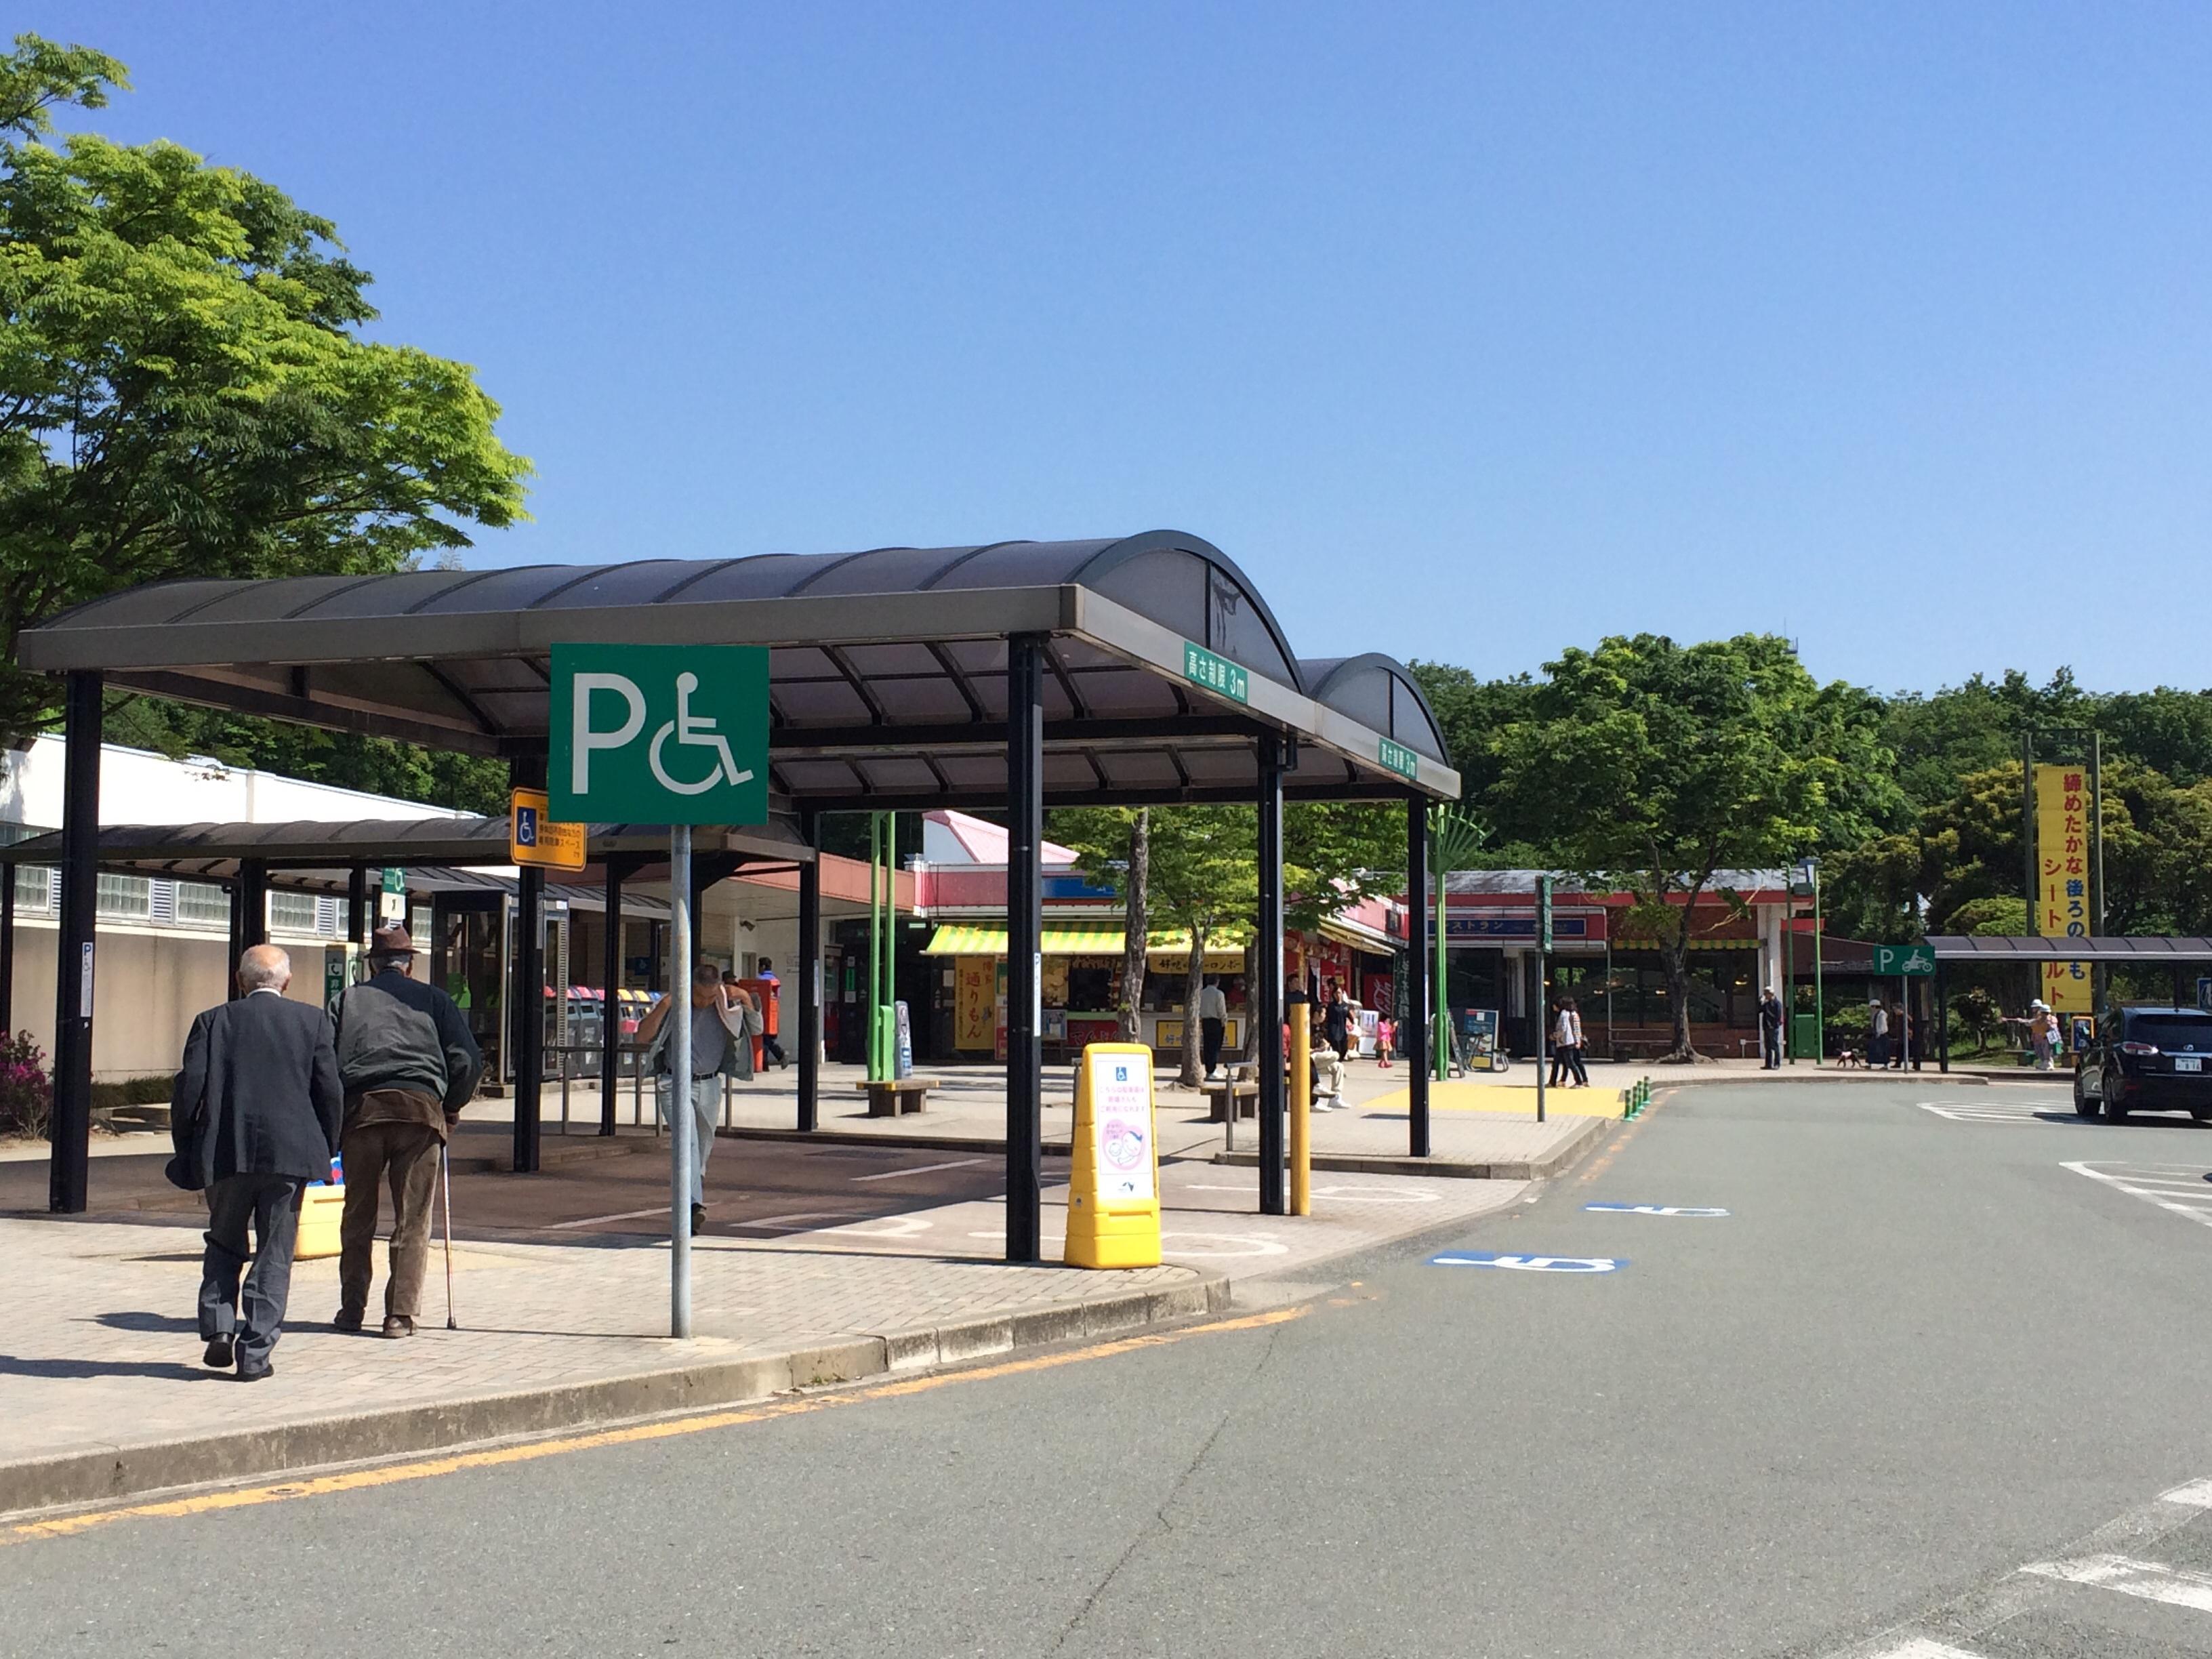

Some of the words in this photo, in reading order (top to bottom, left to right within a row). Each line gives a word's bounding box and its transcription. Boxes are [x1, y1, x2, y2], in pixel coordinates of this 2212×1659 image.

[1188, 651, 1226, 690] 高さ制限
[1229, 668, 1245, 699] 3m
[572, 673, 647, 794] P
[2063, 773, 2085, 981] 締めたかな後ろのも
[83, 944, 91, 956] P
[1443, 920, 1504, 930] ストラン
[2043, 858, 2064, 1006] シートルト
[1879, 949, 1894, 972] P
[966, 972, 981, 1038] 通りもん
